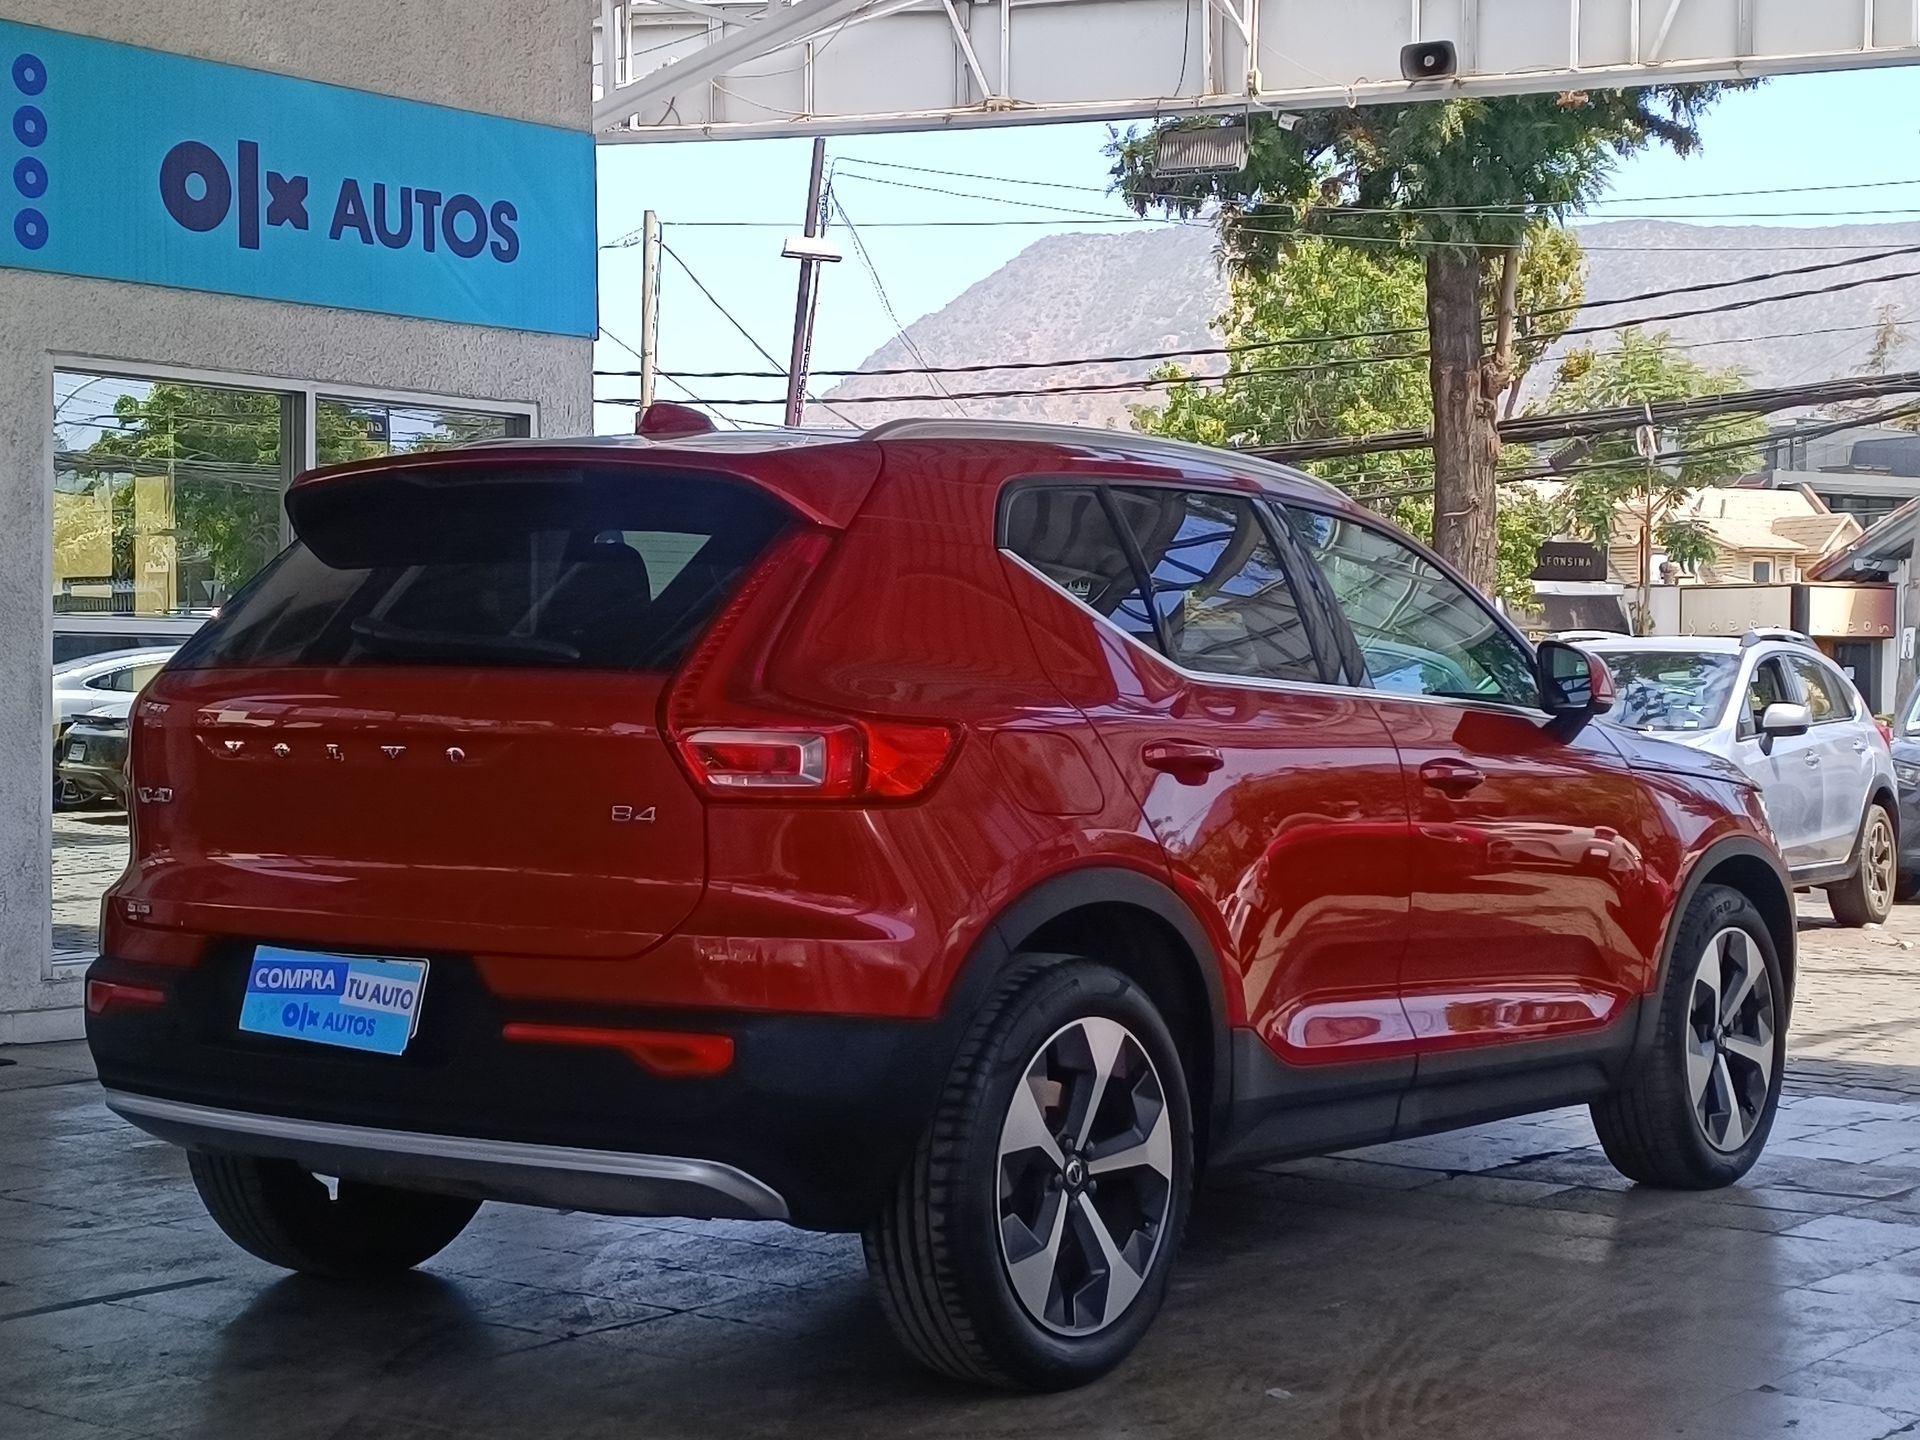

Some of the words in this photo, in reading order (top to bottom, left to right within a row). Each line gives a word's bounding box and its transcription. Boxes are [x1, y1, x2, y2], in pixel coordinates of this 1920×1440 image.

[159, 139, 309, 250] olx
[329, 177, 520, 263] AUTOS
[1540, 556, 1592, 567] LFONSINA
[224, 740, 465, 763] VOLVO
[611, 805, 656, 824] B4
[255, 967, 336, 991] COMPRA
[348, 978, 368, 1000] TU
[368, 983, 414, 1010] AUTO
[322, 1011, 377, 1037] AUTOS
